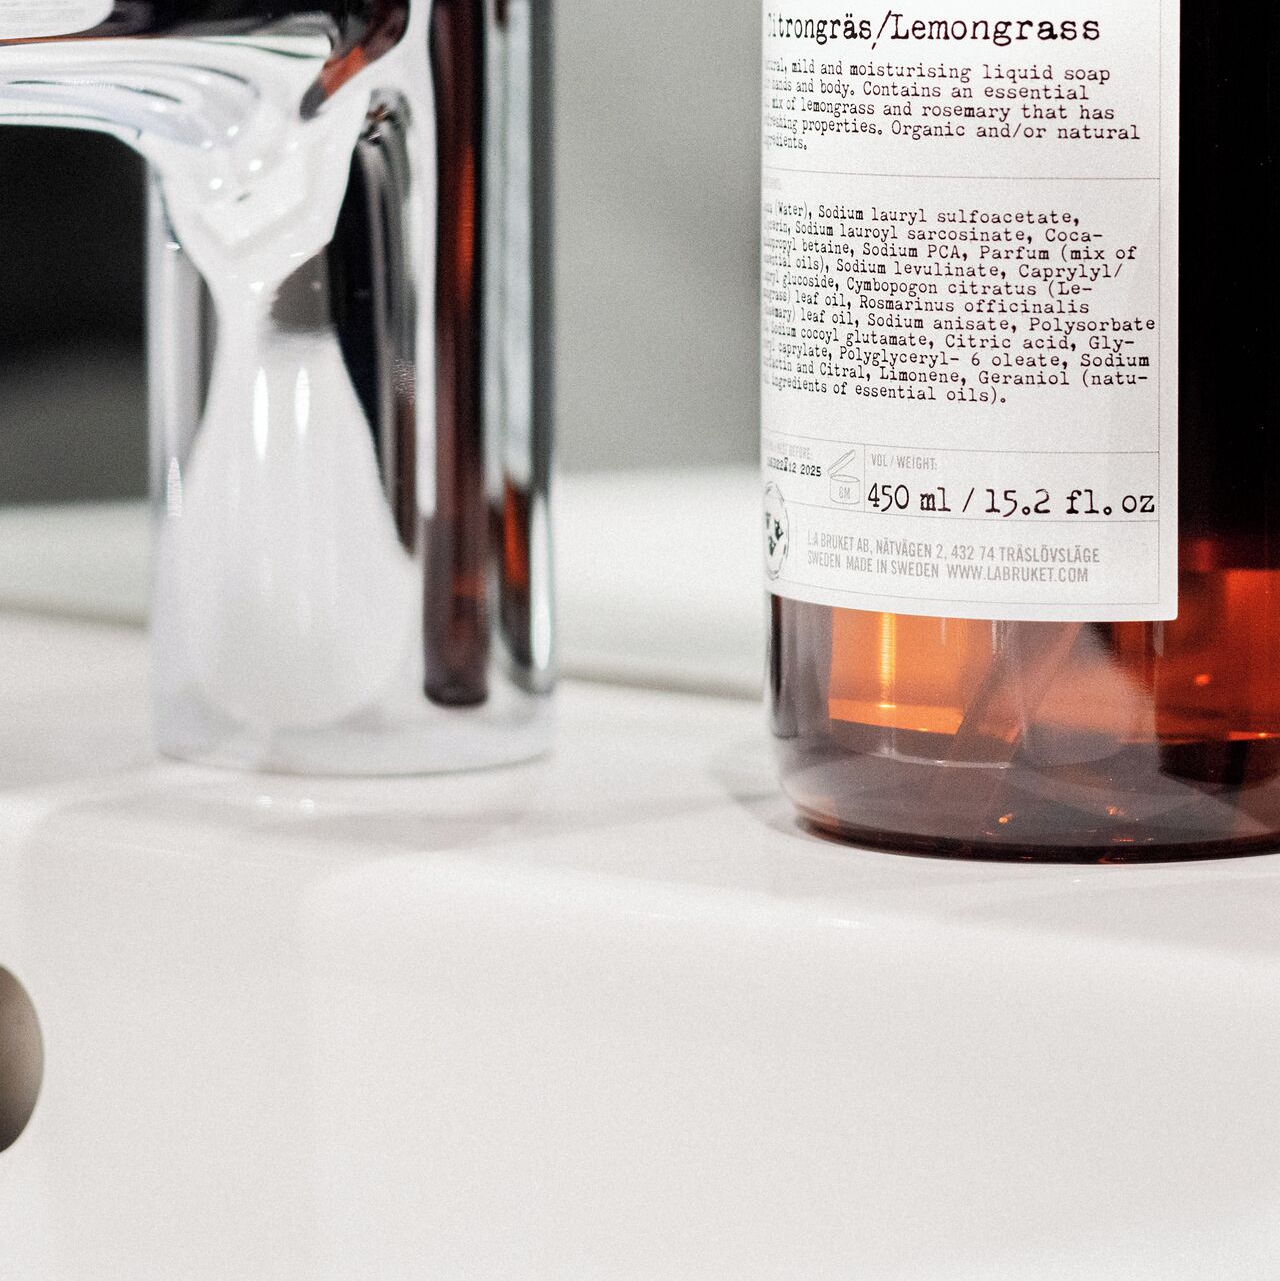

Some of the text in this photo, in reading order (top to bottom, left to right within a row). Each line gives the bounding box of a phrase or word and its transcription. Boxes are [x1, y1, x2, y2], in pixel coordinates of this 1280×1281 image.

[791, 59, 816, 75] mild
[820, 60, 843, 76] and
[849, 62, 972, 84] moisturising
[982, 63, 1054, 84] liquid
[1063, 68, 1111, 86] soap
[795, 81, 815, 93] and
[819, 78, 855, 99] body.
[862, 80, 941, 98] Contains
[950, 86, 973, 99] an
[984, 84, 1090, 101] essential
[786, 99, 796, 111] of
[801, 99, 875, 119] lemongrass
[882, 100, 913, 117] and
[921, 105, 1011, 123] rosemary
[1020, 103, 1068, 120] that
[1079, 104, 1115, 121] has
[801, 118, 883, 136] properties.
[891, 119, 966, 141] Organic
[976, 122, 1047, 139] and/or
[1057, 124, 1141, 140] natural
[818, 204, 864, 221] Sodium
[871, 206, 927, 227] lauryl
[937, 208, 1080, 227] sulfoacetate,
[795, 221, 834, 237] Sodium
[839, 222, 898, 243] lauroyl
[907, 227, 1033, 245] sarcosinate,
[1044, 227, 1103, 243] Coca-
[802, 239, 855, 258] betaine,
[862, 241, 919, 258] Sodium
[927, 243, 968, 262] PCA,
[979, 245, 1050, 261] Parfum
[1061, 243, 1106, 263] (mix
[1115, 245, 1138, 260] of
[795, 255, 830, 274] oils),
[836, 258, 887, 275] Sodium
[894, 260, 1006, 280] levulinate,
[1018, 262, 1123, 282] Caprylyl/
[782, 273, 840, 292] glucoside,
[846, 276, 938, 298] Cymbopogon
[947, 280, 1037, 296] citratus
[1048, 279, 1093, 299] (Le-
[795, 291, 820, 306] leaf
[824, 292, 852, 311] oil,
[859, 294, 955, 313] Rosmarinus
[964, 298, 1090, 314] officinalis
[800, 309, 826, 324] leaf
[831, 310, 859, 329] oil,
[867, 312, 924, 329] Sodium
[933, 315, 1017, 334] anisate,
[1028, 317, 1156, 336] Polysorbate
[801, 327, 840, 345] cocoyl
[845, 328, 934, 350] glutamate,
[945, 333, 1011, 349] Citric
[1022, 334, 1077, 352] acid,
[1088, 334, 1135, 354] Gly-
[778, 343, 833, 362] caprylate,
[839, 345, 960, 370] Polyglyceryl-
[971, 351, 981, 367] 6
[991, 352, 1068, 371] oleate,
[1080, 352, 1150, 368] Sodium
[796, 360, 815, 375] and
[819, 361, 871, 382] Citral,
[879, 365, 967, 387] Limonene,
[978, 370, 1070, 386] Geraniol
[1082, 368, 1148, 388] (natu-
[832, 381, 848, 396] of
[855, 384, 937, 401] essential
[946, 385, 1006, 405] oils).
[801, 463, 822, 477] 2025
[871, 453, 889, 467] VOL
[868, 483, 1155, 517] 450 ml / 15.2 fl. oz
[821, 532, 853, 551] BRUKET
[951, 544, 975, 560] 432
[980, 546, 996, 561] 74
[808, 550, 1089, 583] SWEDEN MADE IN SWEDEN WWW.LABRUKET.COM
